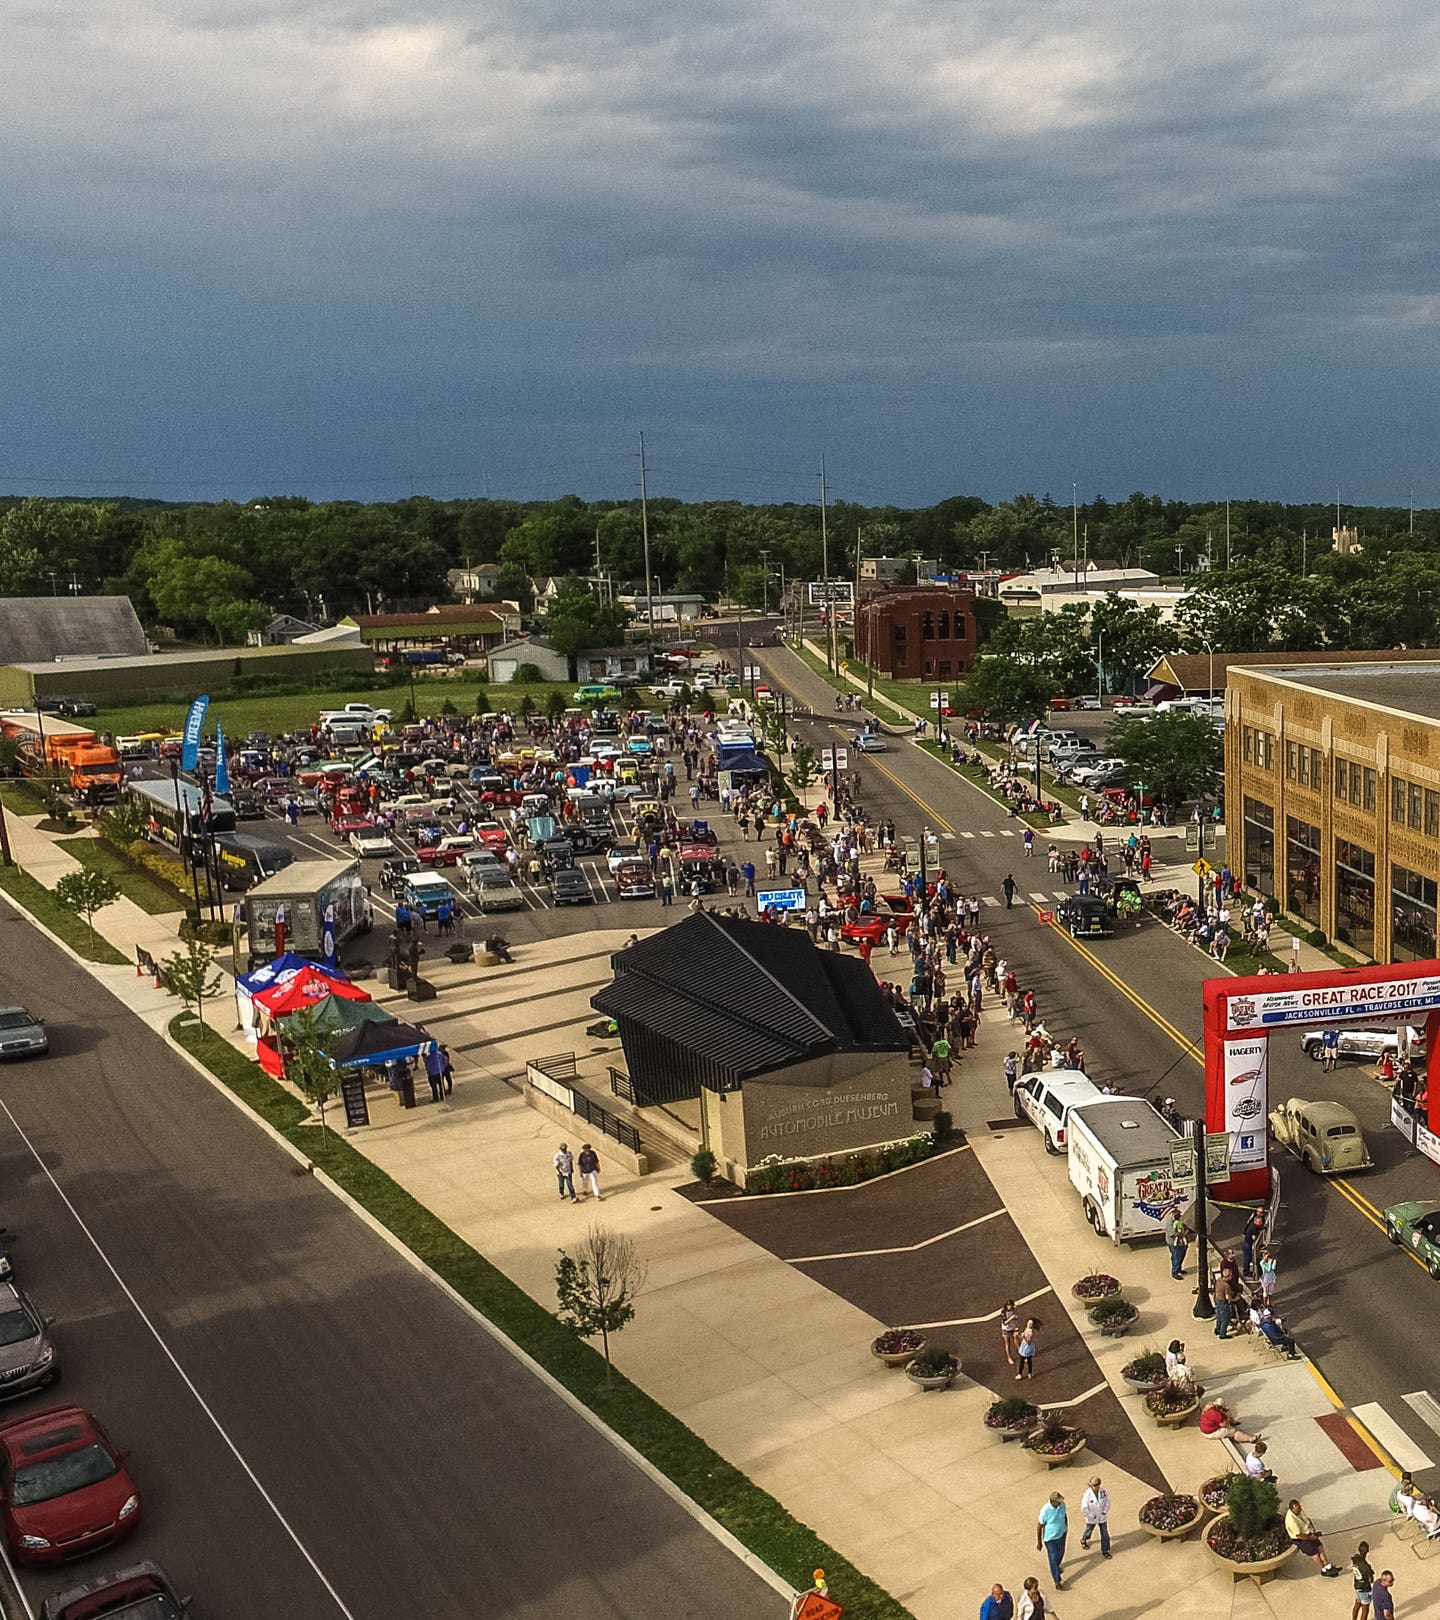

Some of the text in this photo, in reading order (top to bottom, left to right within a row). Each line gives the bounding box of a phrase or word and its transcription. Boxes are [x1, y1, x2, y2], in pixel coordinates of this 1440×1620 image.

[1302, 982, 1417, 1006] GREAT RACE 2017
[1284, 1008, 1343, 1020] JACKSONVILLE,
[1345, 1005, 1355, 1014] FL
[1364, 1000, 1402, 1012] TRAVERSE
[1404, 998, 1425, 1008] CITY,
[1229, 1046, 1264, 1056] HAGERTY
[768, 1092, 889, 1121] AUBURN CORD DUESENBERG
[760, 1102, 898, 1139] AUTOMOBILE MUSEUM
[805, 1603, 824, 1617] ROAD
